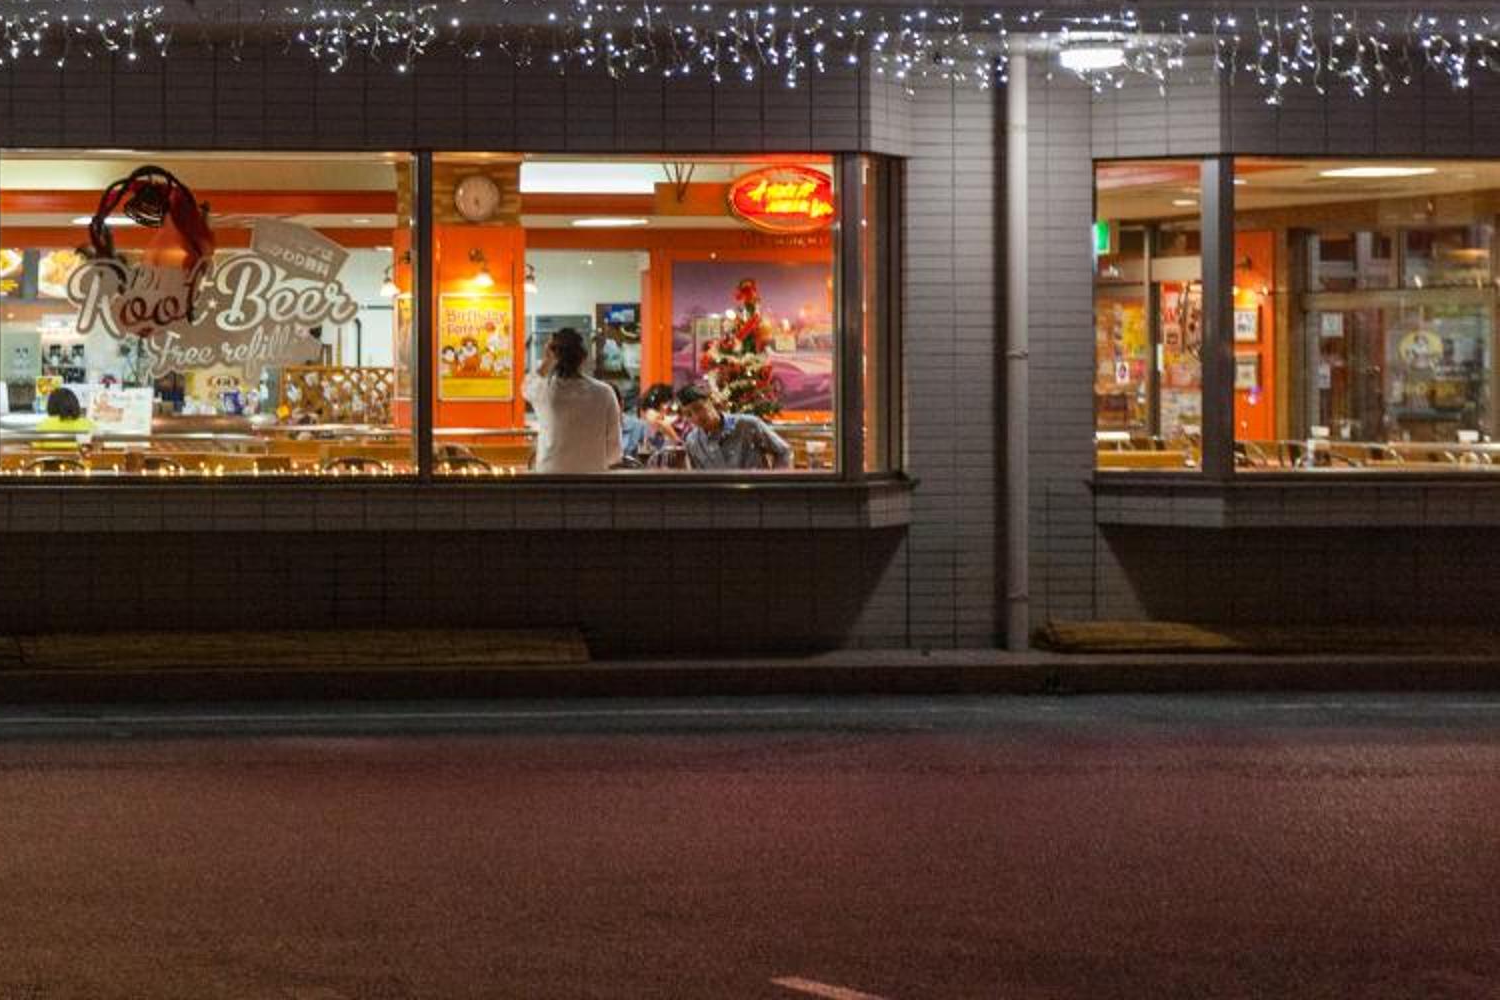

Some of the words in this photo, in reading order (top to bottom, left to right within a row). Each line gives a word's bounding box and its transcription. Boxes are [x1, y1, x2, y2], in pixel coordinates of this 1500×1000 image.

[68, 261, 214, 335] Root
[216, 257, 357, 331] Beer
[151, 331, 213, 376] Free
[221, 325, 291, 377] refill
